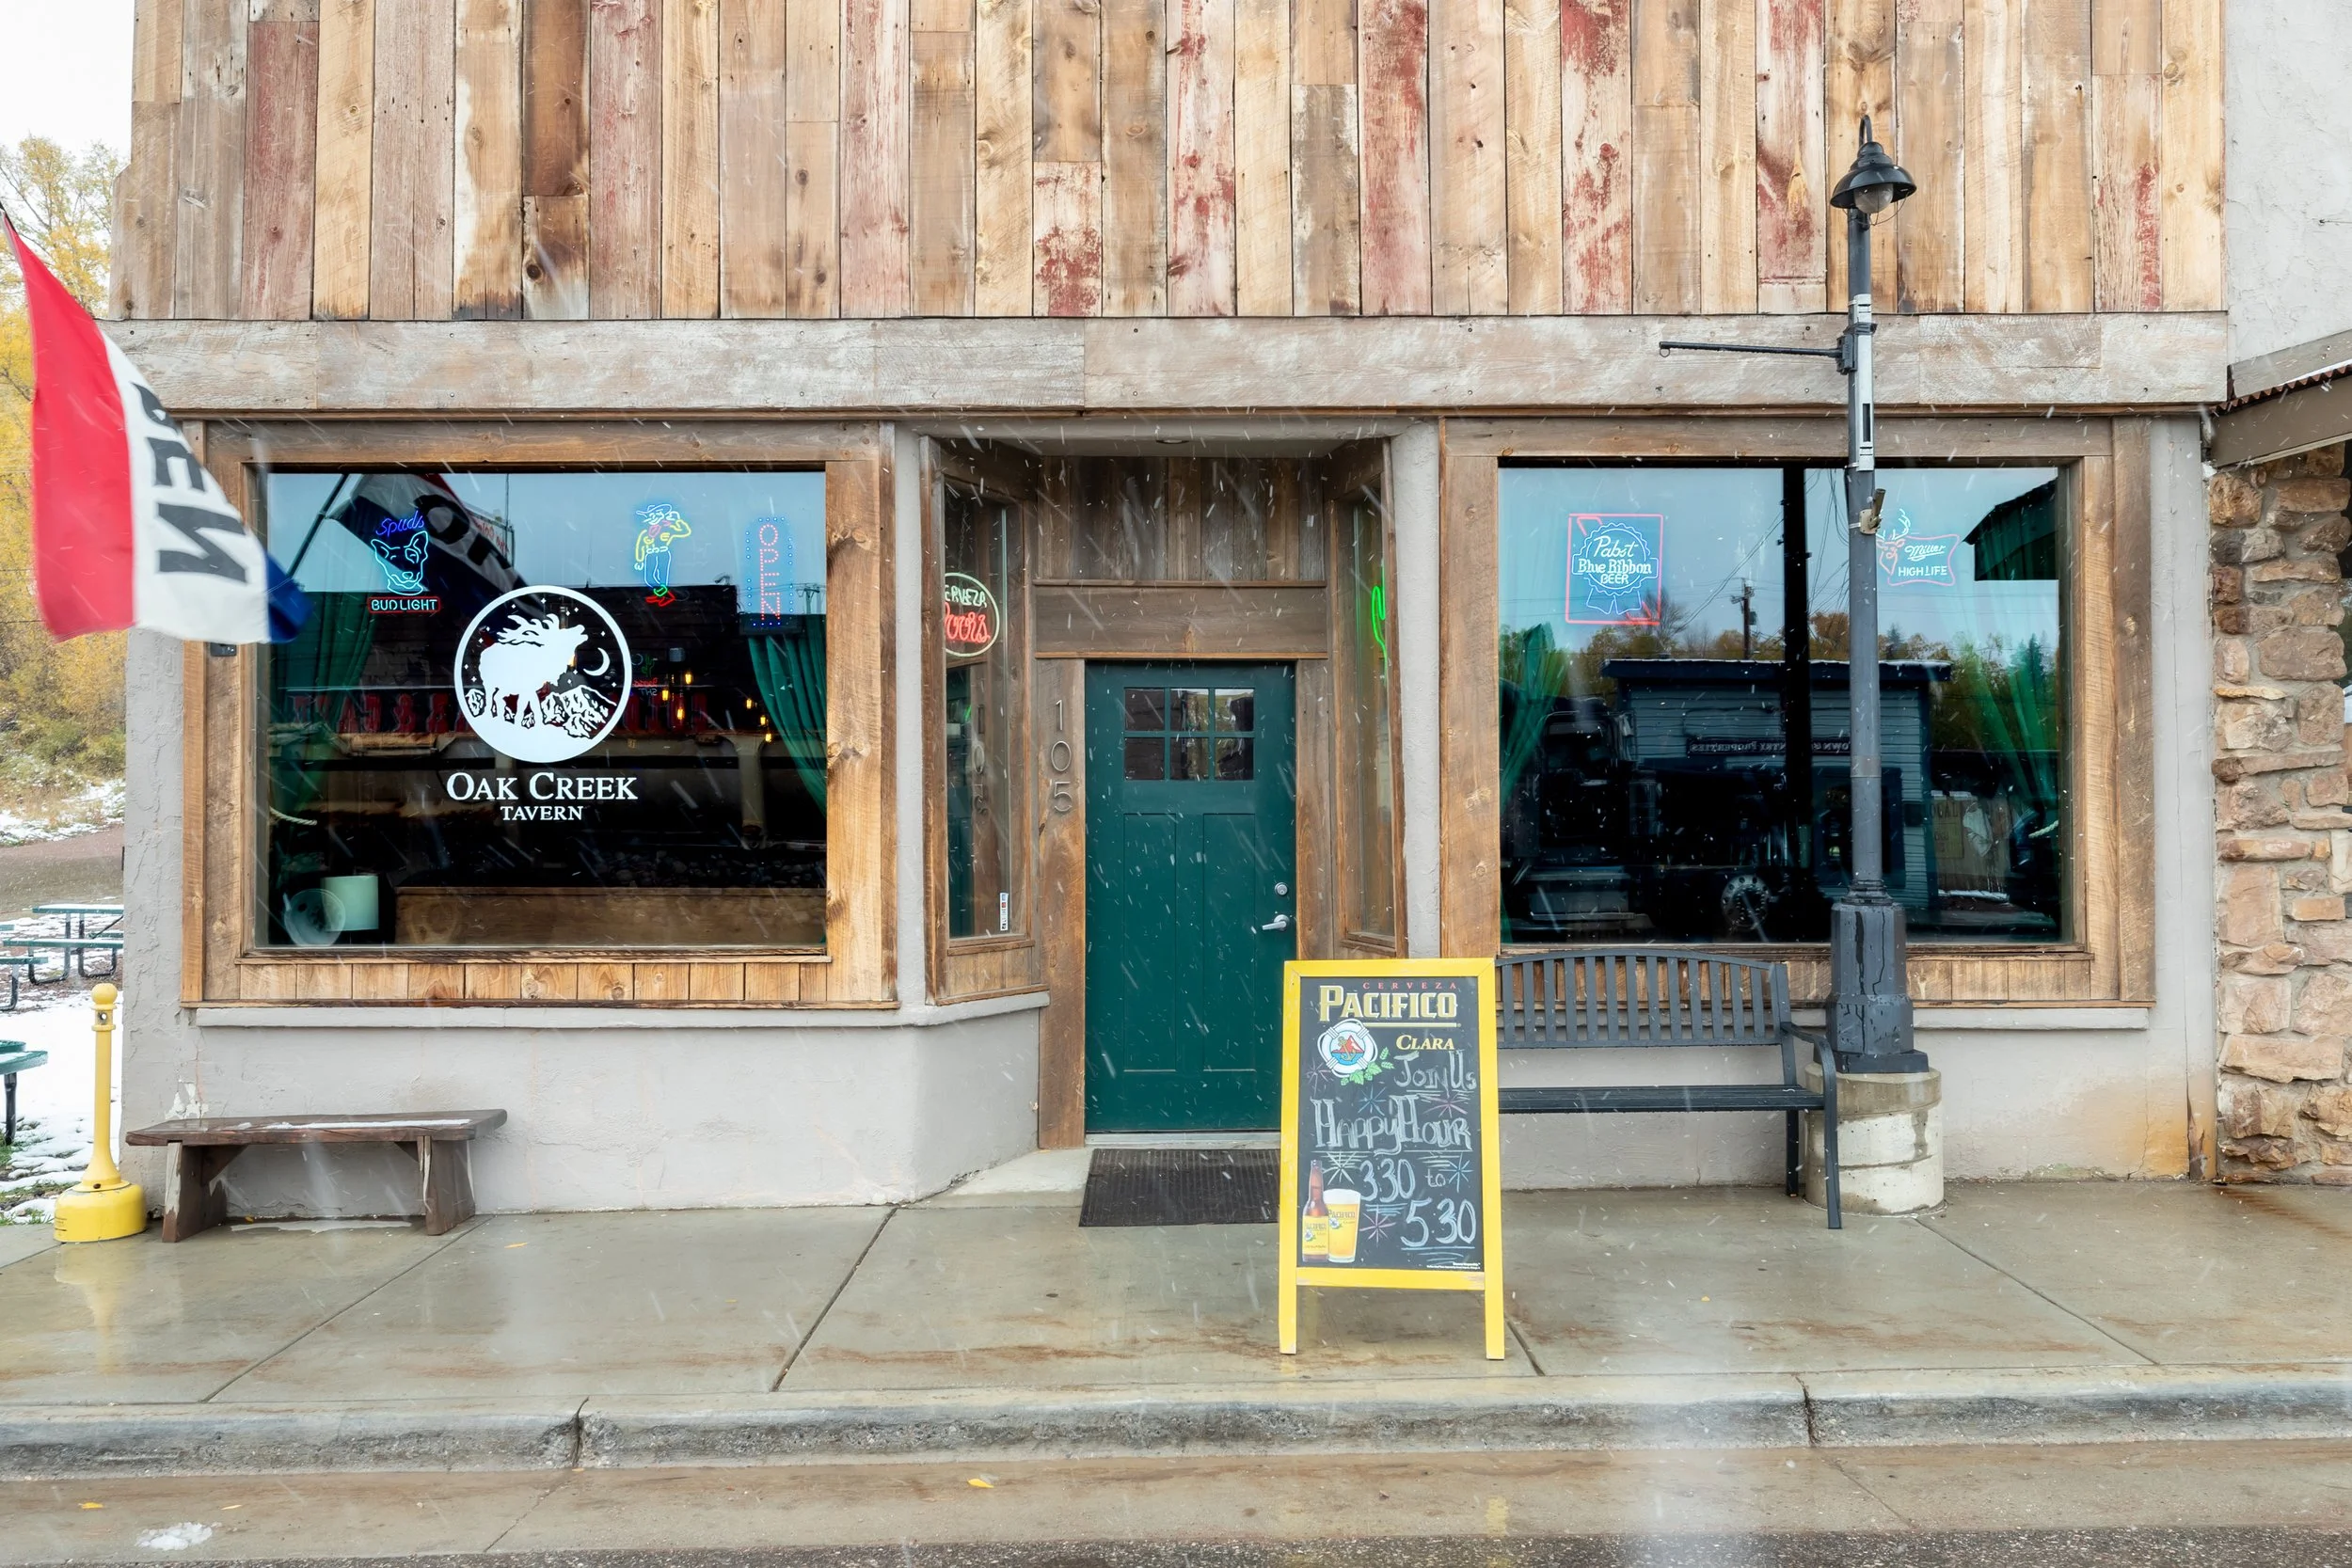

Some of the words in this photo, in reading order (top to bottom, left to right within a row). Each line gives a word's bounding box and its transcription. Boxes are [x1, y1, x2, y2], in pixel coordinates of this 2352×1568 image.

[130, 382, 249, 585] PEN
[375, 511, 424, 538] Spuds
[1594, 535, 1639, 558] Pabst
[1904, 545, 1947, 560] Miller
[759, 524, 781, 621] OPEN
[1578, 559, 1606, 573] Blue
[1607, 559, 1652, 575] Ribbon
[1898, 566, 1924, 577] HIGH
[1925, 565, 1947, 576] LIFE
[1600, 573, 1629, 585] BEER
[371, 599, 398, 611] BUD
[400, 599, 437, 611] LIGHT
[945, 584, 988, 609] ERVEZA
[446, 771, 519, 800] OAK
[529, 771, 639, 800] CREEK
[500, 805, 584, 821] TAVERN
[1319, 985, 1458, 1022] PACIFICO
[1395, 1034, 1455, 1051] CLARA
[1424, 1168, 1447, 1188] to
